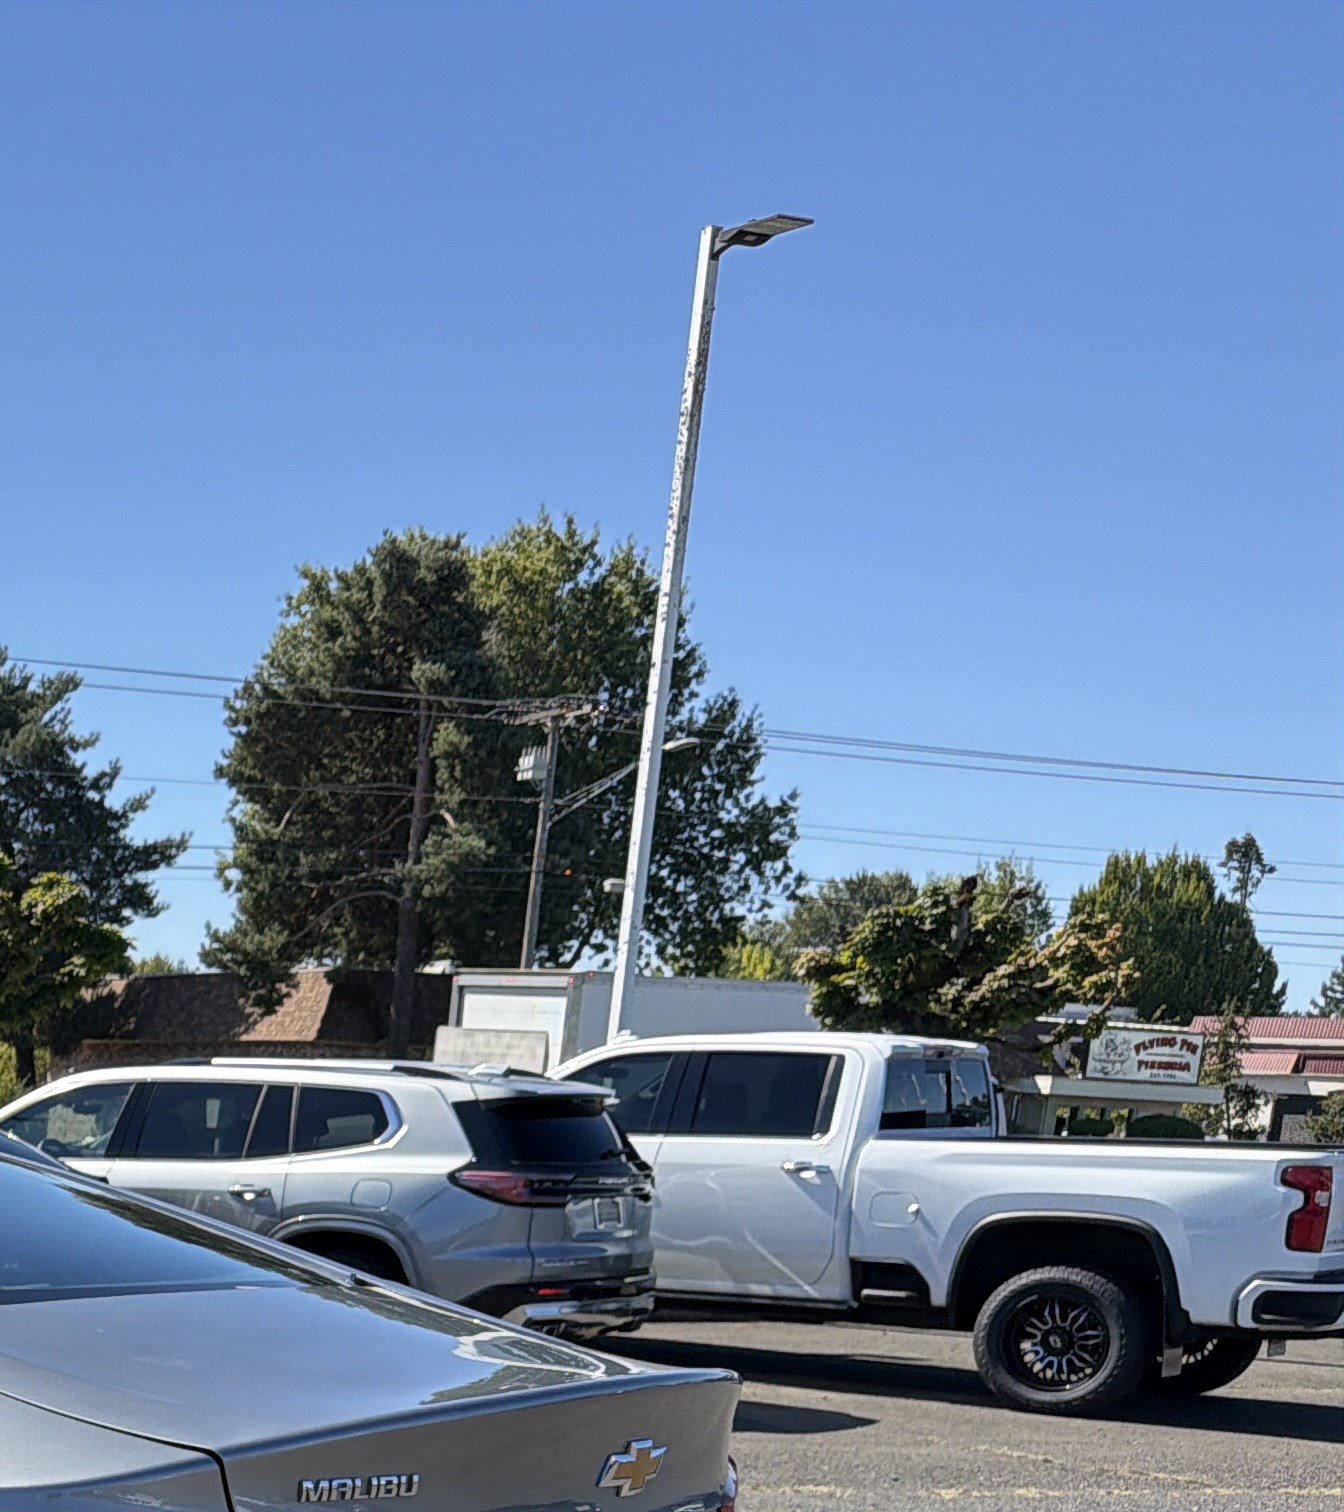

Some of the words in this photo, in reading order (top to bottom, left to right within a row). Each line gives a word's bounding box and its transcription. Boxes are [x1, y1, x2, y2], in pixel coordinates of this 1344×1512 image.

[1133, 1037, 1179, 1056] FLYING
[1179, 1038, 1200, 1056] PIE
[1137, 1059, 1192, 1073] PIZZERIA
[298, 1474, 420, 1502] MALIBU
